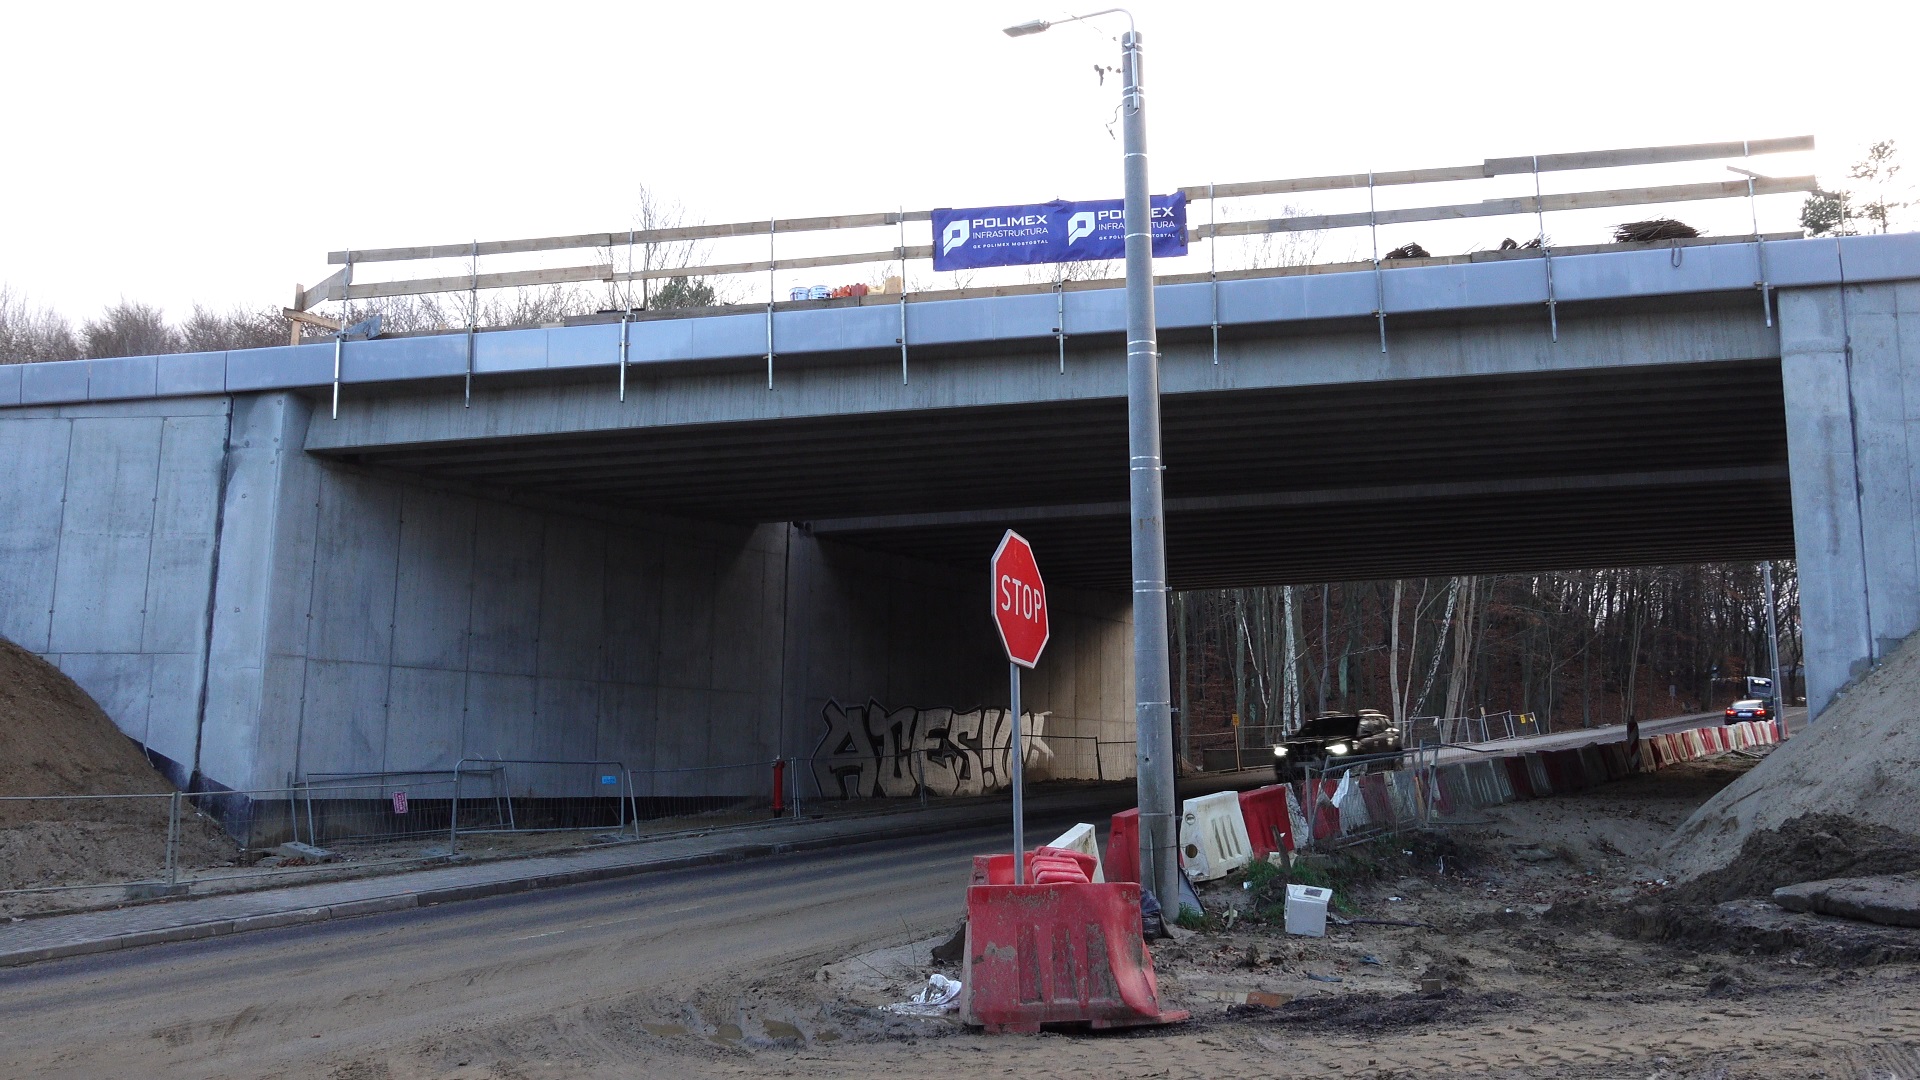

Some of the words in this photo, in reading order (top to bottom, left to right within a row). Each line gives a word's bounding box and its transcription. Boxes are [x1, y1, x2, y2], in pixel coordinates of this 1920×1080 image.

[1098, 206, 1175, 220] POEX
[973, 214, 1048, 229] POLIMEX
[1098, 220, 1176, 230] INFRATURA
[973, 227, 1049, 239] INFRASTRUKTURA
[1001, 574, 1042, 623] STOP
